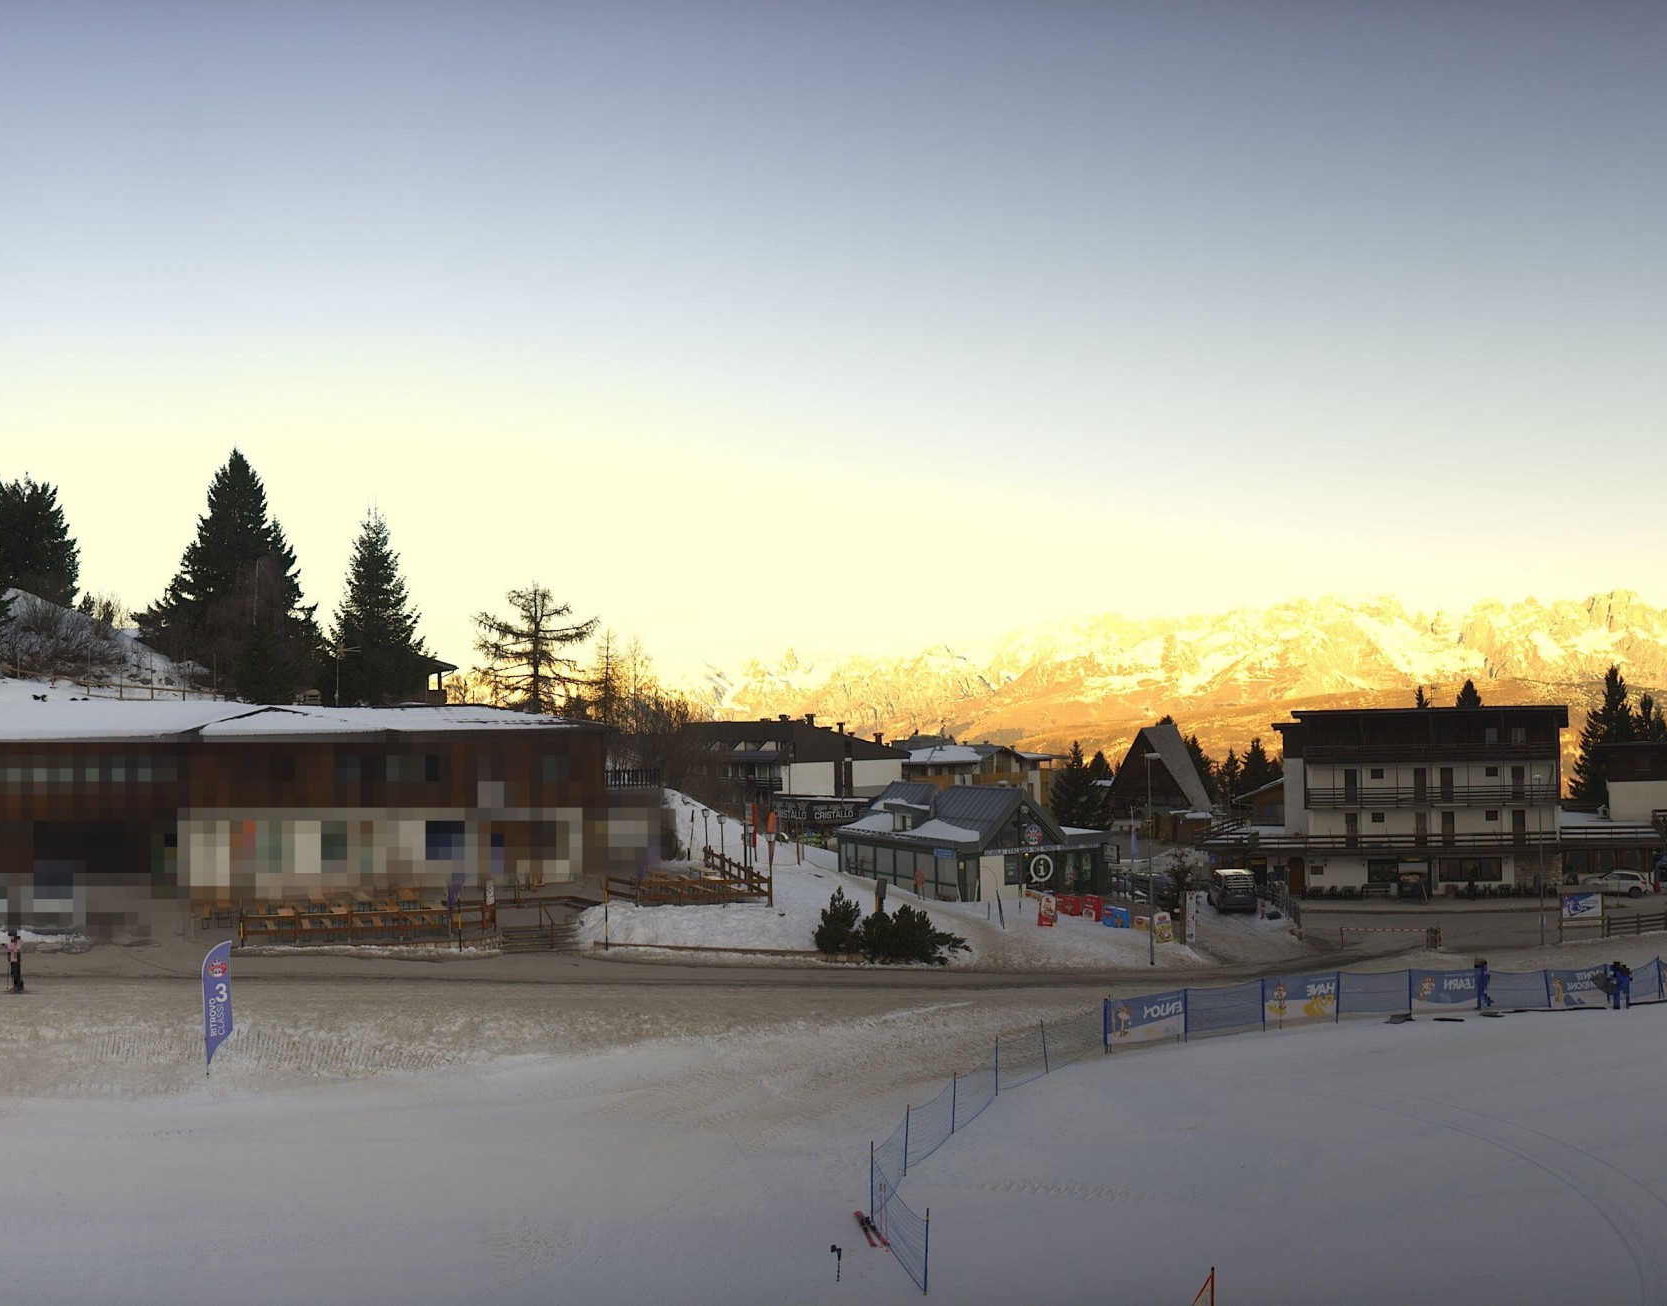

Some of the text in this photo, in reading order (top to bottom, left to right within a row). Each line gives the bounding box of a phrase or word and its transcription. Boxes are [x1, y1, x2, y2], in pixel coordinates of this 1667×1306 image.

[814, 810, 854, 820] CRISTALLO
[215, 982, 228, 1003] 3
[208, 997, 218, 1037] RITROVO
[216, 1003, 226, 1036] CLASSI
